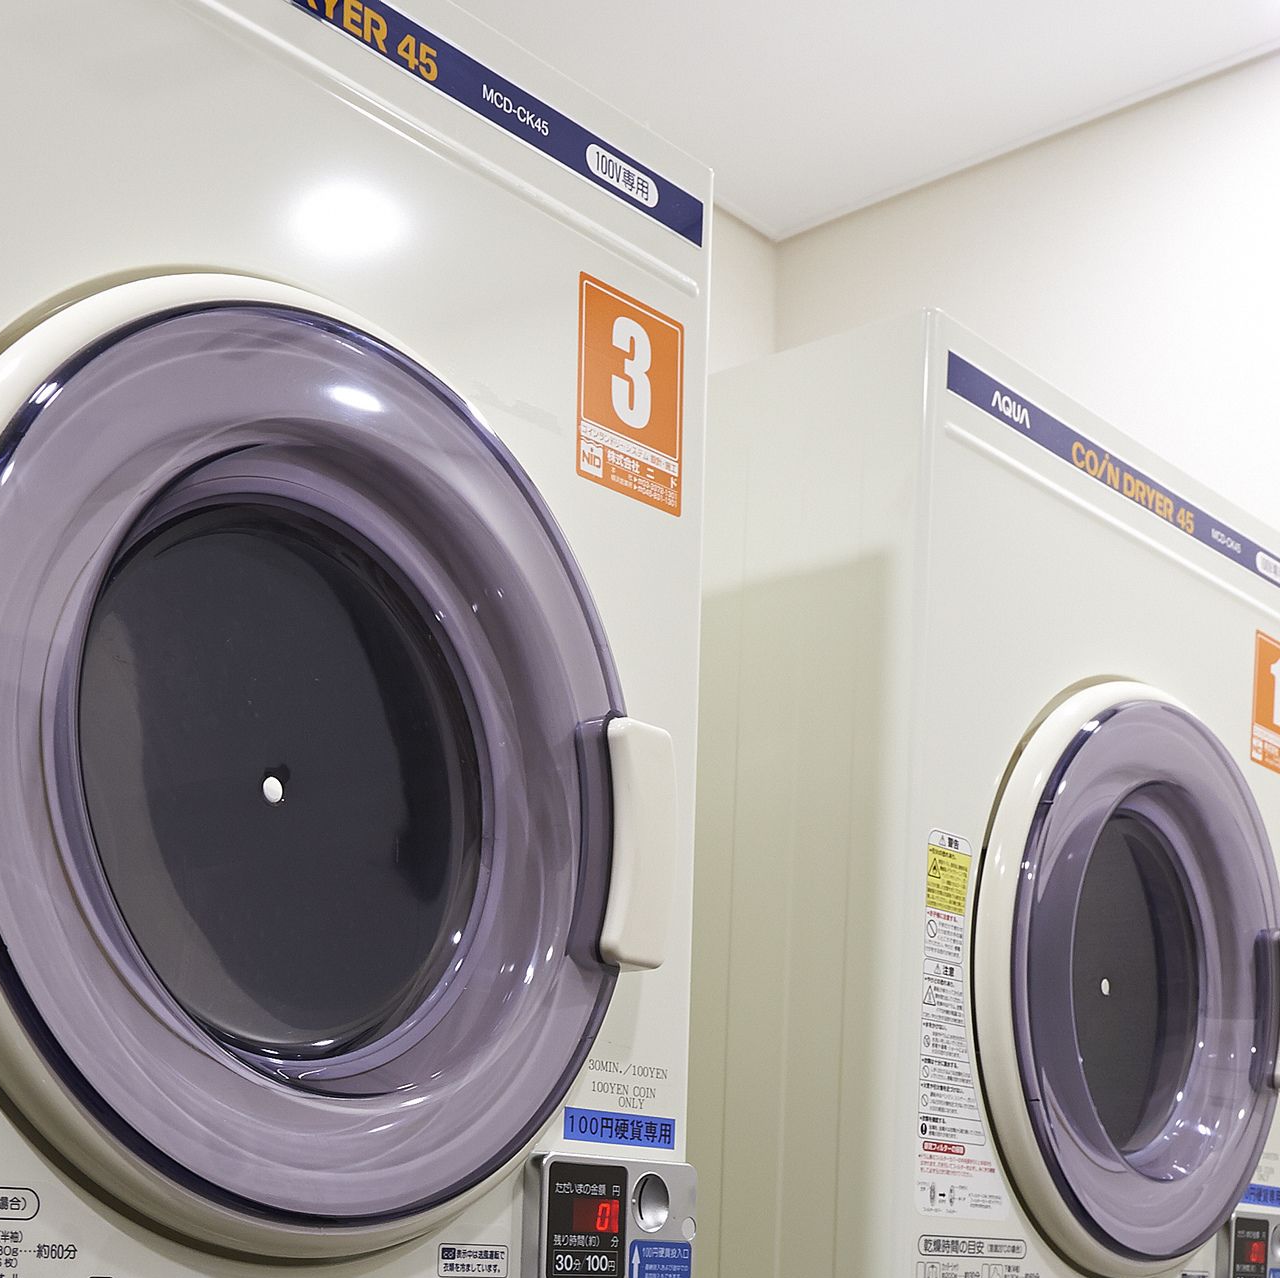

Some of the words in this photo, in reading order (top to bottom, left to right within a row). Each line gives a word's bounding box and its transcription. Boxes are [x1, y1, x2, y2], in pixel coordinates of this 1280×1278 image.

[308, 0, 387, 53] YER
[397, 34, 438, 81] 45
[482, 83, 549, 137] MCD-CK45
[594, 150, 650, 203] 100V専用
[611, 316, 651, 429] 3
[992, 391, 1030, 428] AQUA
[1123, 472, 1174, 522] DRYER
[1177, 508, 1195, 534] 45
[592, 1081, 629, 1096] 100YEN
[633, 1085, 656, 1099] COIN
[619, 1097, 644, 1110] ONLY
[568, 1114, 672, 1144] 100円硬貨専用
[612, 1185, 620, 1196] 円
[611, 1236, 619, 1247] 分
